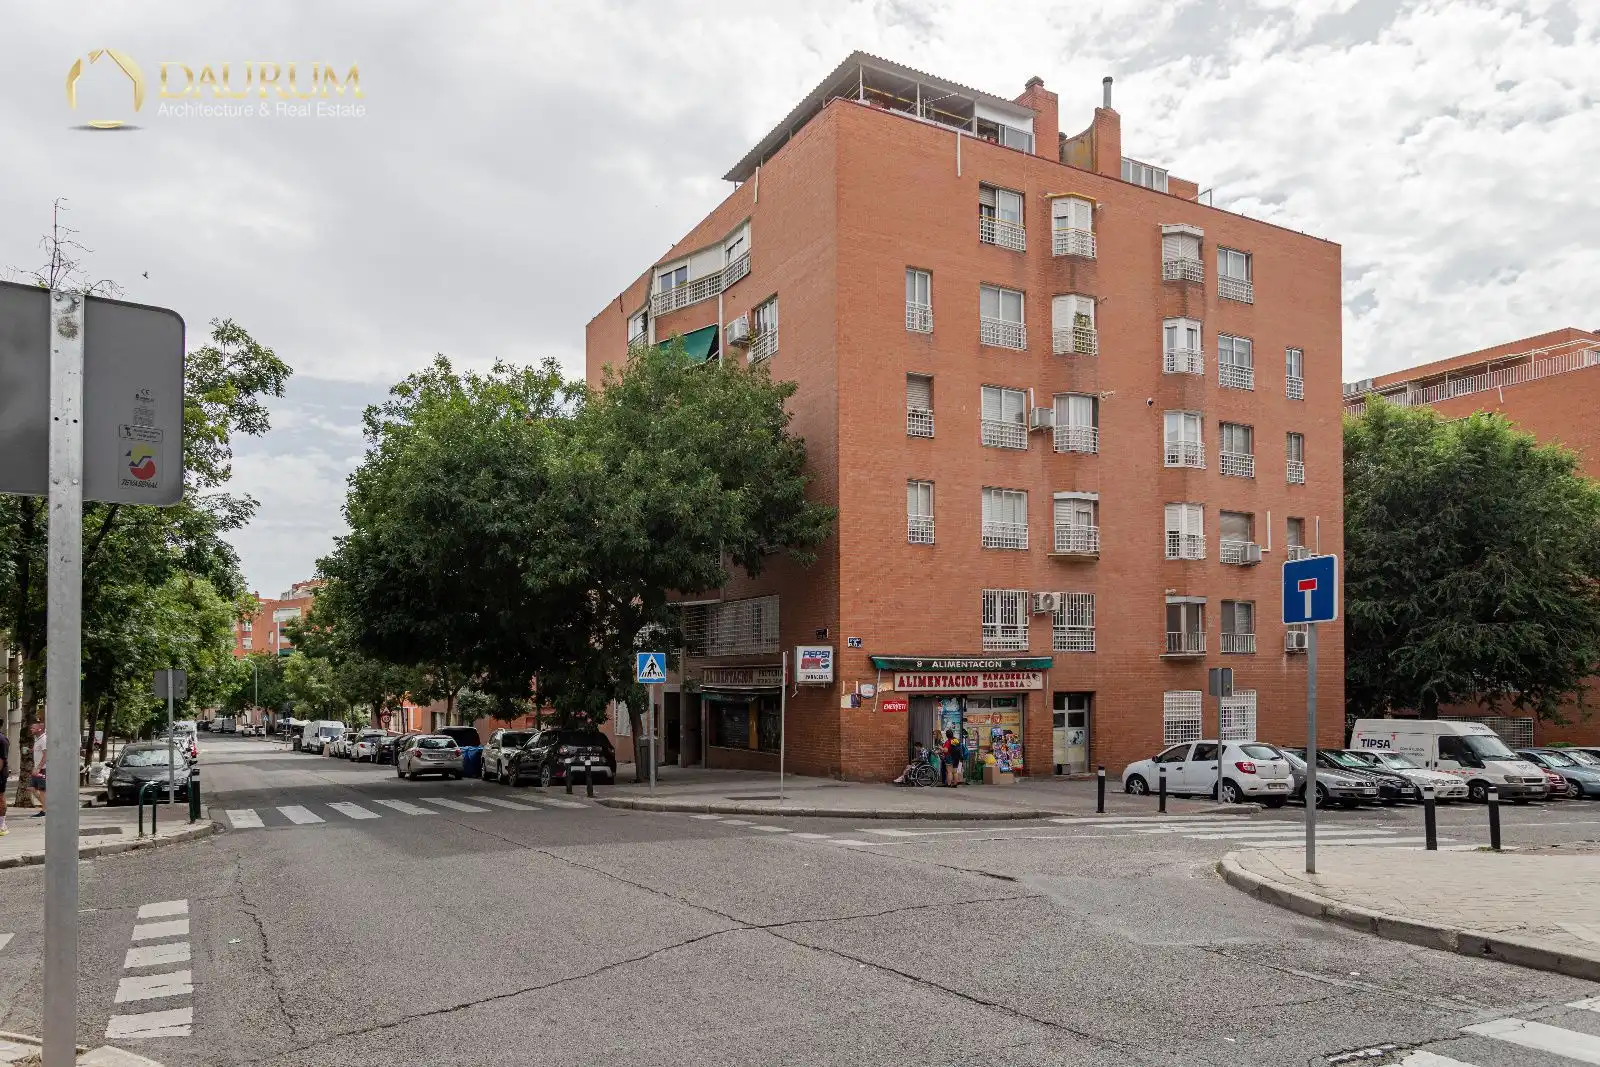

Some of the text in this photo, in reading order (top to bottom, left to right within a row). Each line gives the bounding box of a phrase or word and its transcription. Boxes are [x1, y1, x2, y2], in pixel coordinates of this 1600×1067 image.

[803, 650, 831, 659] PEPSI
[931, 661, 1002, 669] ALIMENTACION
[898, 675, 979, 688] ALIMENTACION
[982, 681, 1025, 689] BOLLERIA
[1360, 738, 1391, 749] TIPSA
